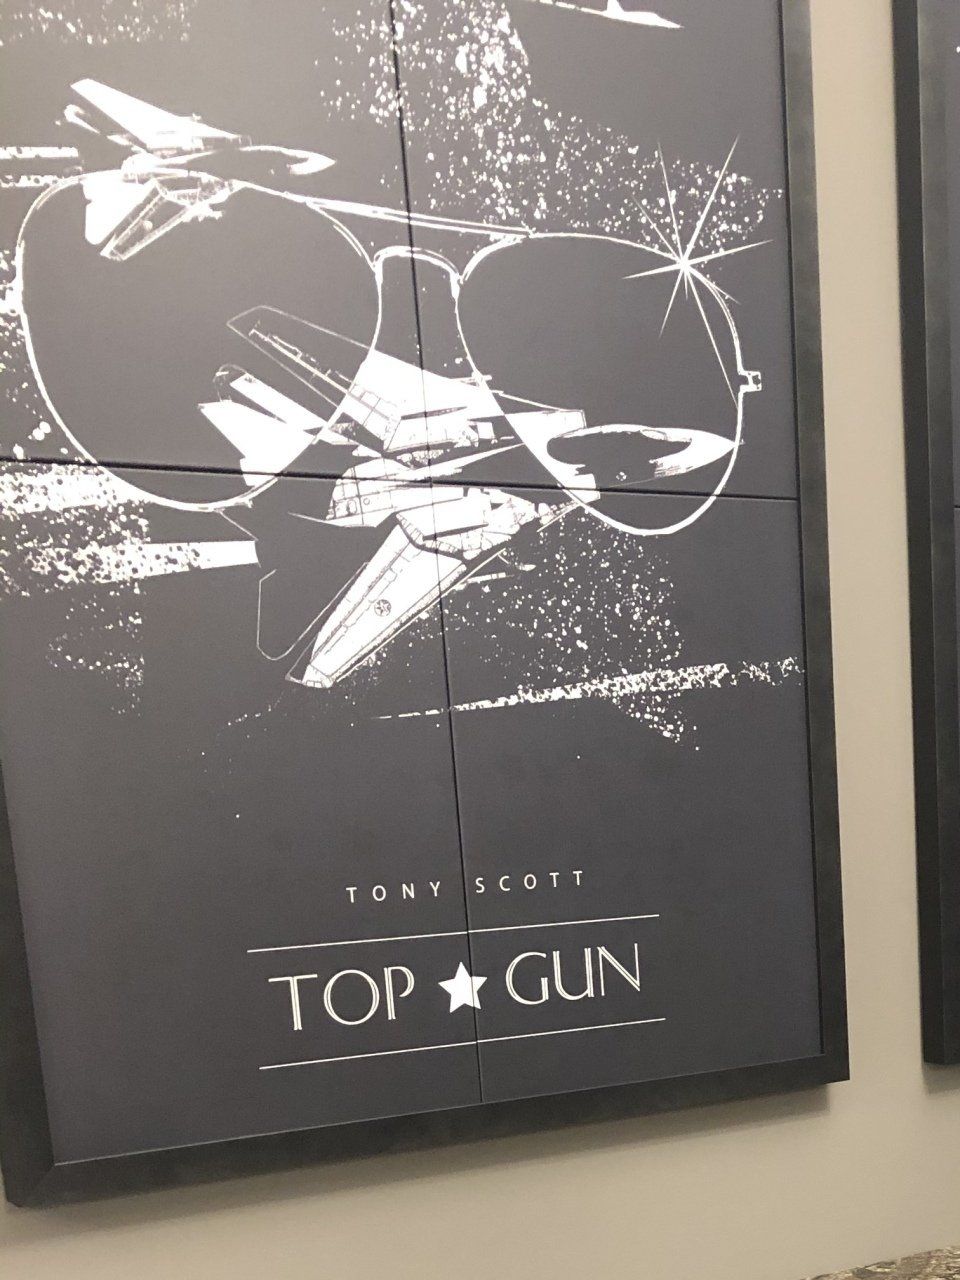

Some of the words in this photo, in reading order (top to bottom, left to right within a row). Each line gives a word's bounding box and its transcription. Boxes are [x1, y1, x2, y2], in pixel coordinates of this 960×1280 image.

[346, 880, 442, 904] TONY
[475, 870, 586, 894] SCOTT
[268, 965, 414, 1031] TOP
[505, 942, 641, 1005] GUN
